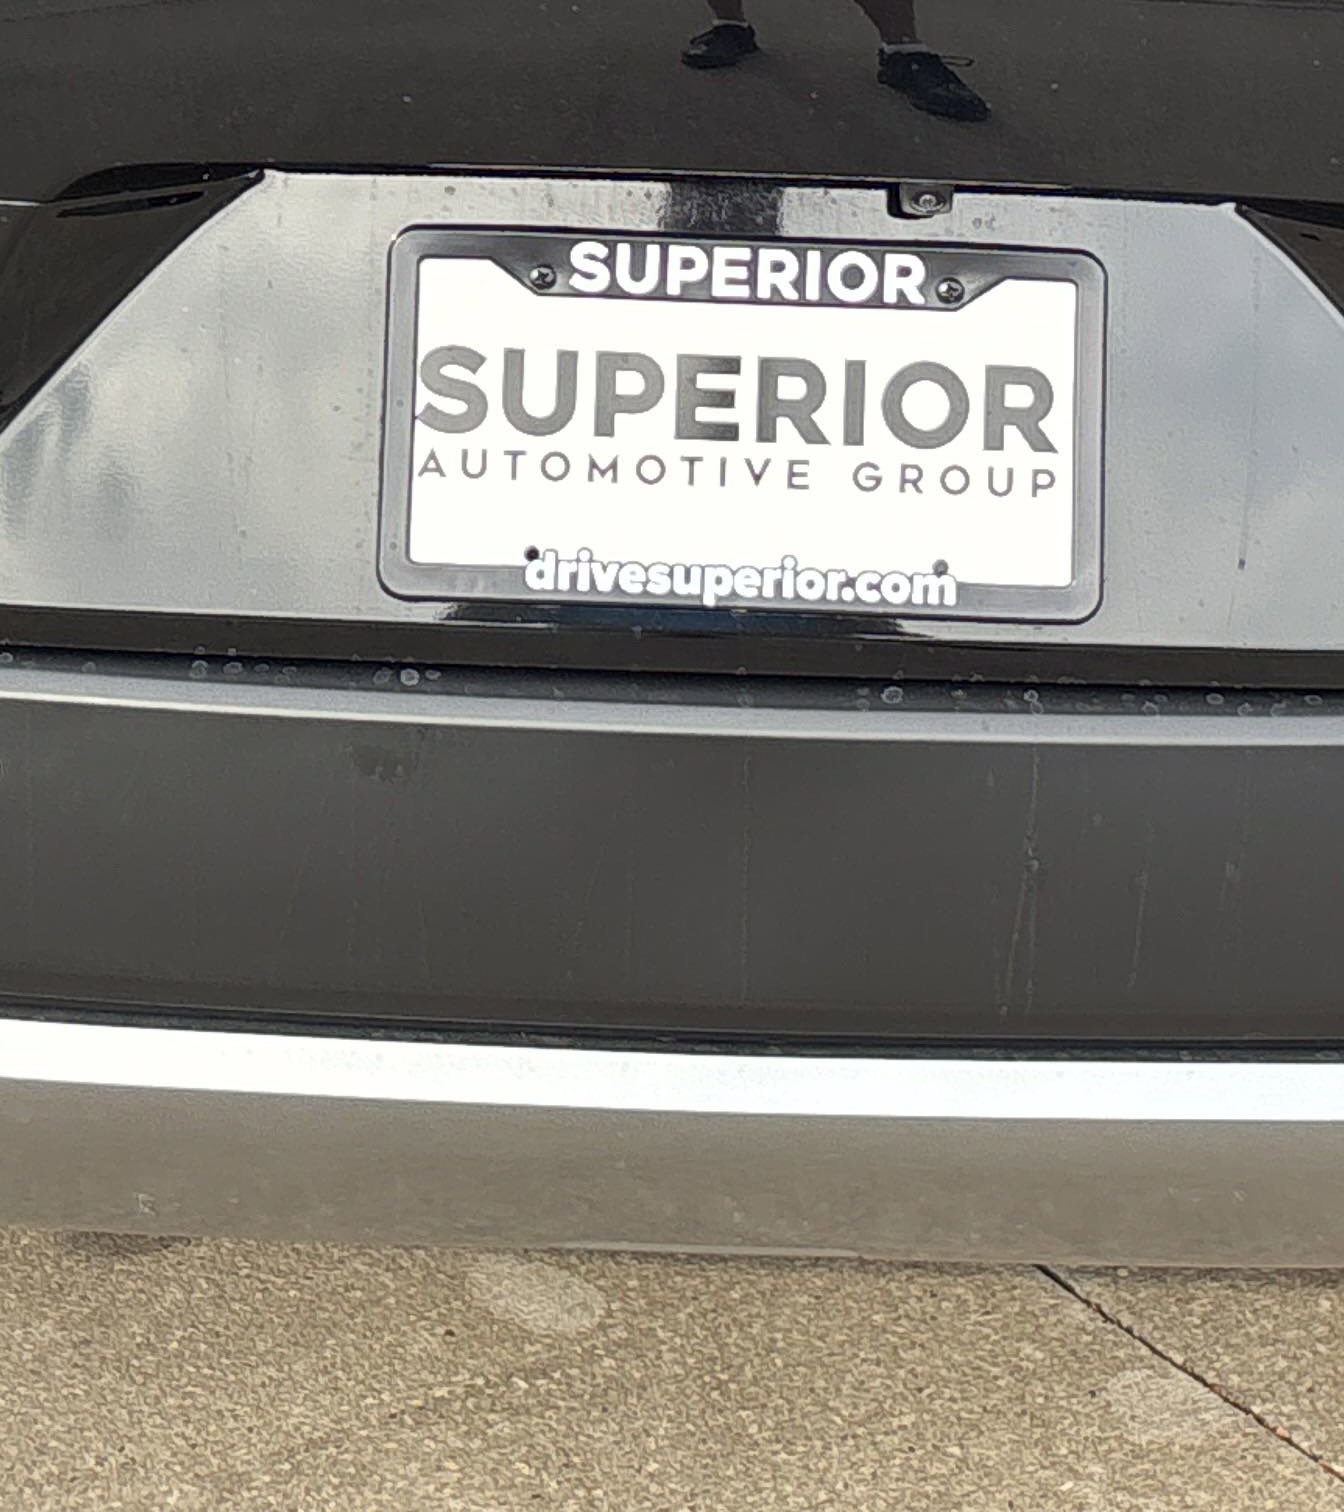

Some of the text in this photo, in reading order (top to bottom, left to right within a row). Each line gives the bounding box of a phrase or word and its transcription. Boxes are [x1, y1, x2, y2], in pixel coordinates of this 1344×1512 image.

[567, 242, 928, 306] SUPERIOR
[415, 344, 1058, 455] SUPERIOR
[417, 448, 1056, 499] AUTOMOTIVE GROUP
[523, 546, 958, 608] drivesuperior.com
